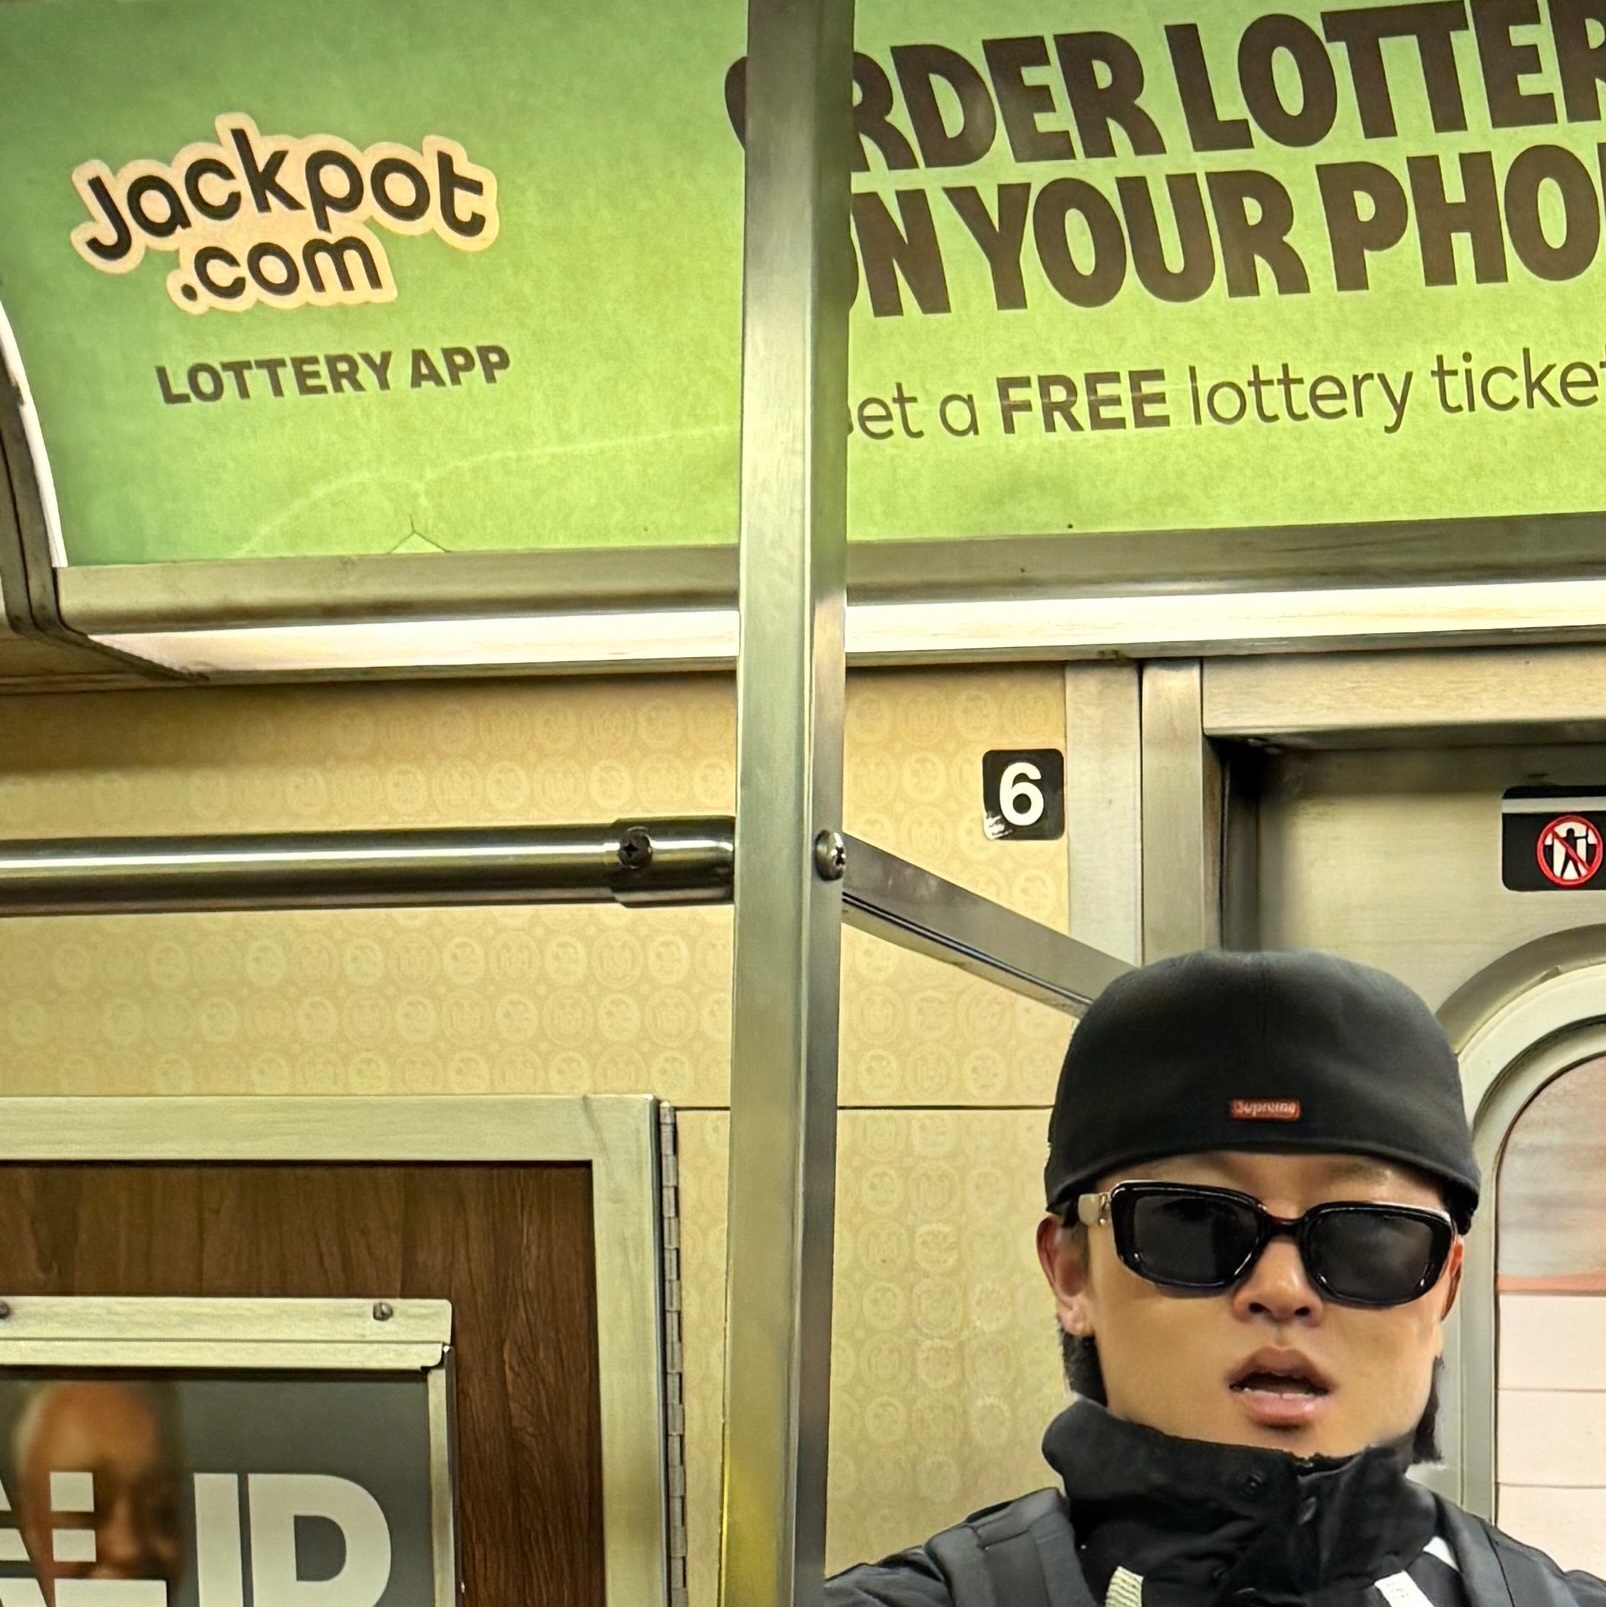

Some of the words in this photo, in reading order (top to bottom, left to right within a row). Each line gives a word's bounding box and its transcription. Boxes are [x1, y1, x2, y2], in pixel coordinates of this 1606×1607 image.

[725, 31, 1167, 173] RDER
[86, 129, 485, 260] Jackpot
[182, 236, 382, 300] .com
[849, 185, 951, 318] N
[942, 170, 1310, 310] YOUR
[155, 351, 392, 404] LOTTERY
[411, 345, 510, 389] APP
[848, 383, 923, 440] et
[940, 395, 979, 437] a
[999, 370, 1169, 434] FREE
[1189, 366, 1413, 433] lottery
[1000, 761, 1044, 826] 6
